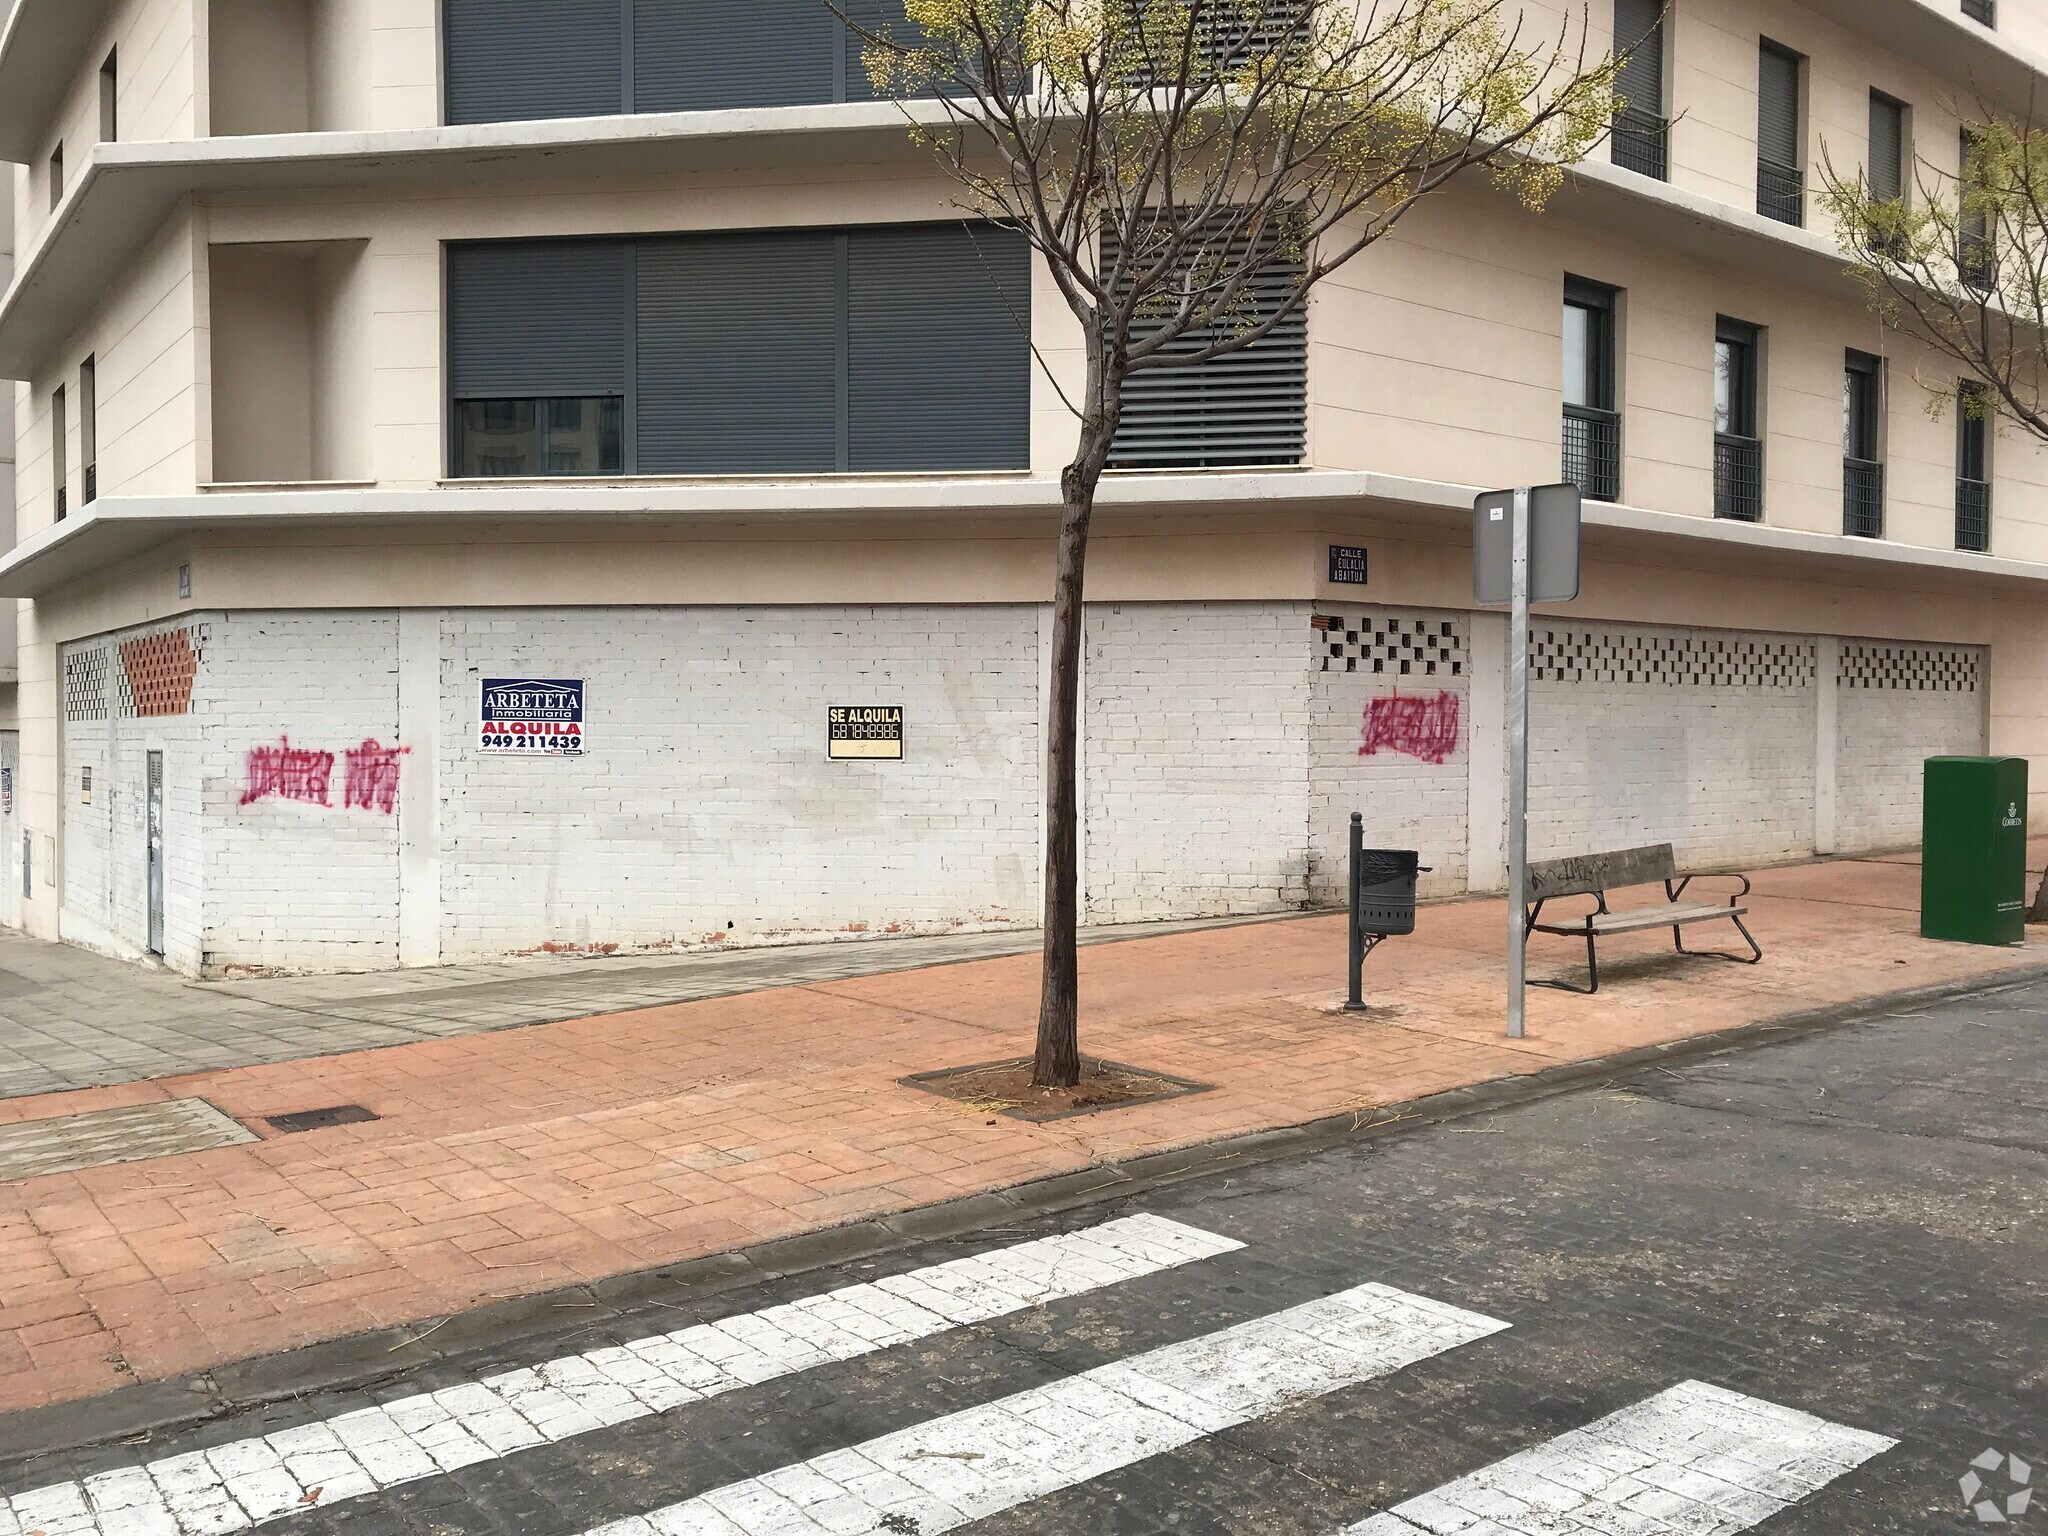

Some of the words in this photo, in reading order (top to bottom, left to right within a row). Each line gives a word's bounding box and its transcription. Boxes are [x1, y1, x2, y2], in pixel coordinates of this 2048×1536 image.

[1341, 549, 1362, 558] CALLE
[1338, 558, 1364, 570] EULALIA
[1334, 570, 1363, 581] ABAITUA
[485, 693, 579, 708] ARBETETA
[492, 709, 571, 718] Inmobiliaria
[830, 709, 845, 722] SE
[848, 709, 900, 723] ALQUILA
[482, 722, 581, 735] ALQUILA
[832, 724, 898, 738] 687848986
[482, 735, 513, 747] 949
[516, 736, 581, 748] 211439
